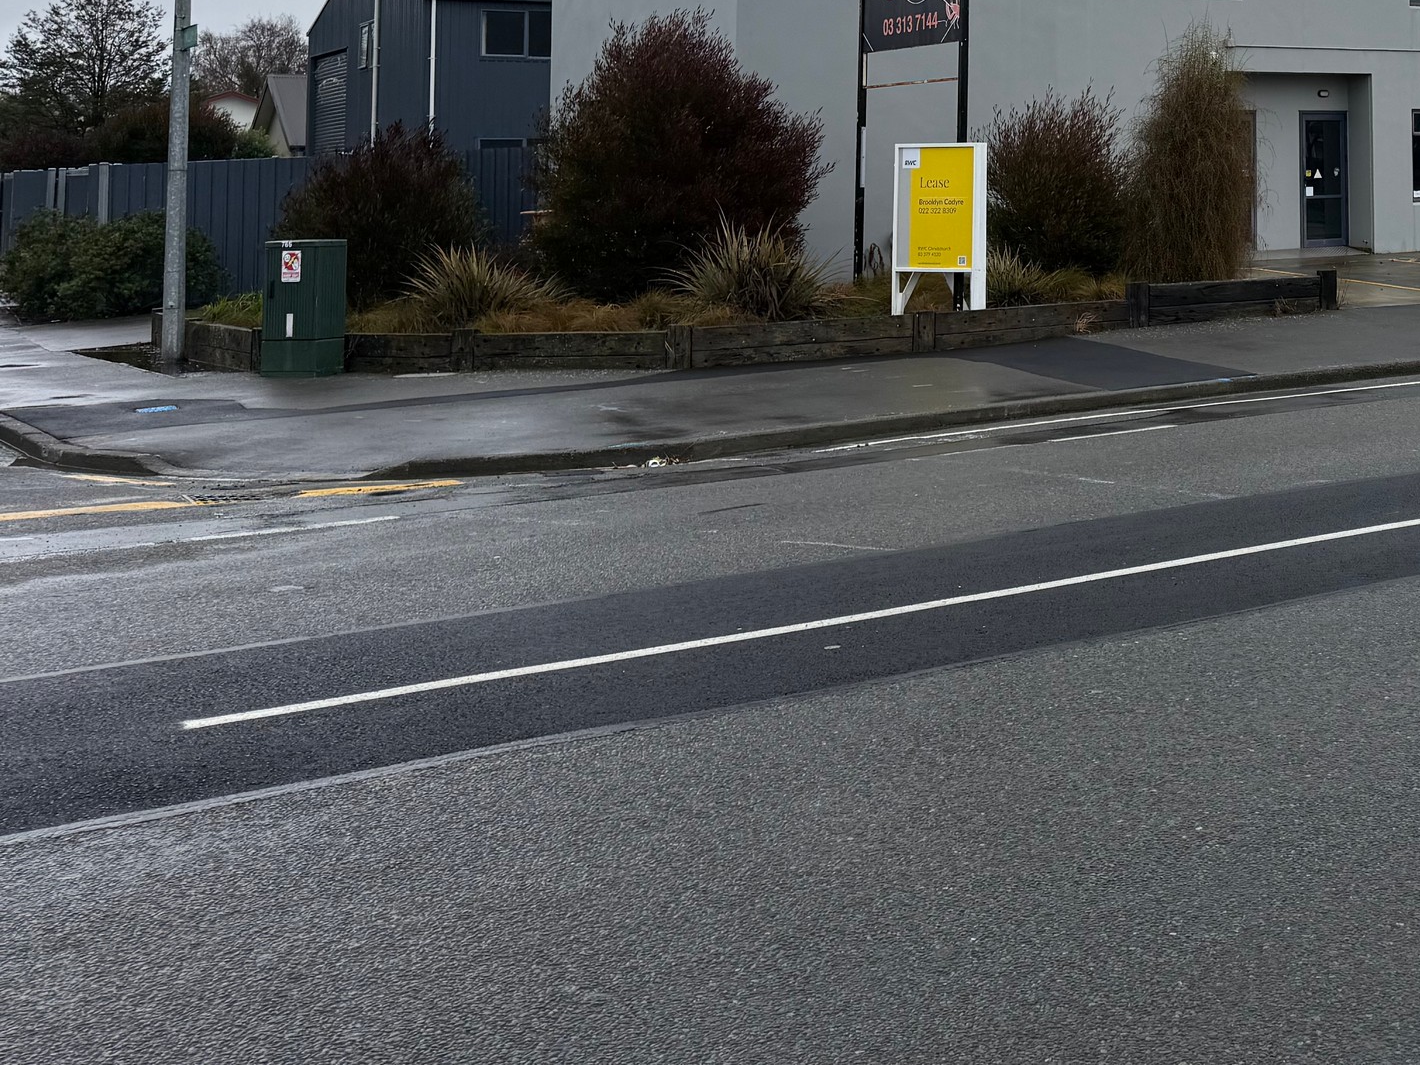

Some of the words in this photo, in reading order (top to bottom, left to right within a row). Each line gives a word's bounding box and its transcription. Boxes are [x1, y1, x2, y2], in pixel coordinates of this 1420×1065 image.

[883, 18, 894, 36] 03
[896, 14, 913, 35] 313
[915, 11, 938, 31] 7144
[920, 176, 950, 189] Lease
[919, 198, 943, 206] Brooklyn
